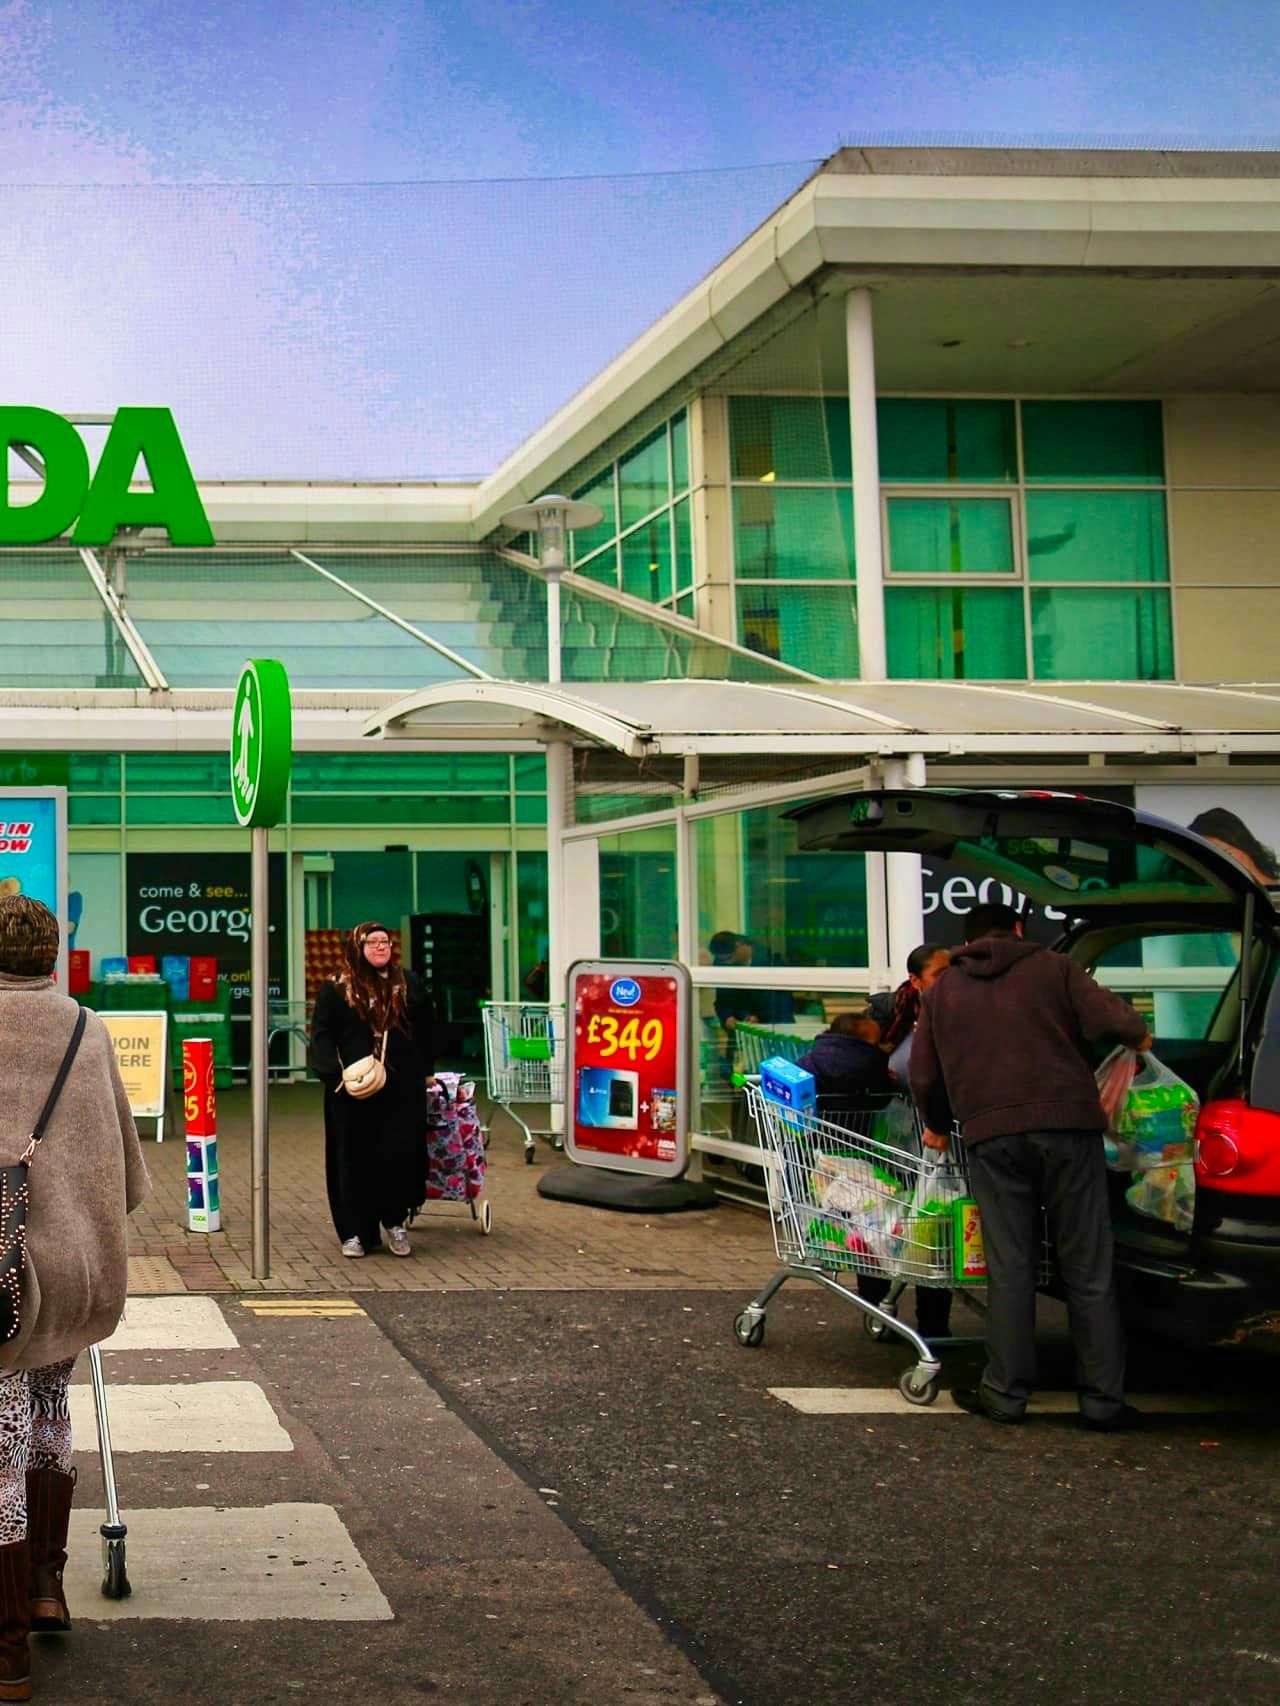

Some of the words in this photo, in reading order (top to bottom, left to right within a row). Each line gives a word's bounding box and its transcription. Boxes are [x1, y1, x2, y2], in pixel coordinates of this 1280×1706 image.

[7, 822, 33, 837] IN
[139, 887, 183, 898] come
[189, 883, 202, 898] &
[206, 886, 249, 898] see...
[587, 1014, 663, 1061] £349
[115, 1054, 152, 1068] ERE
